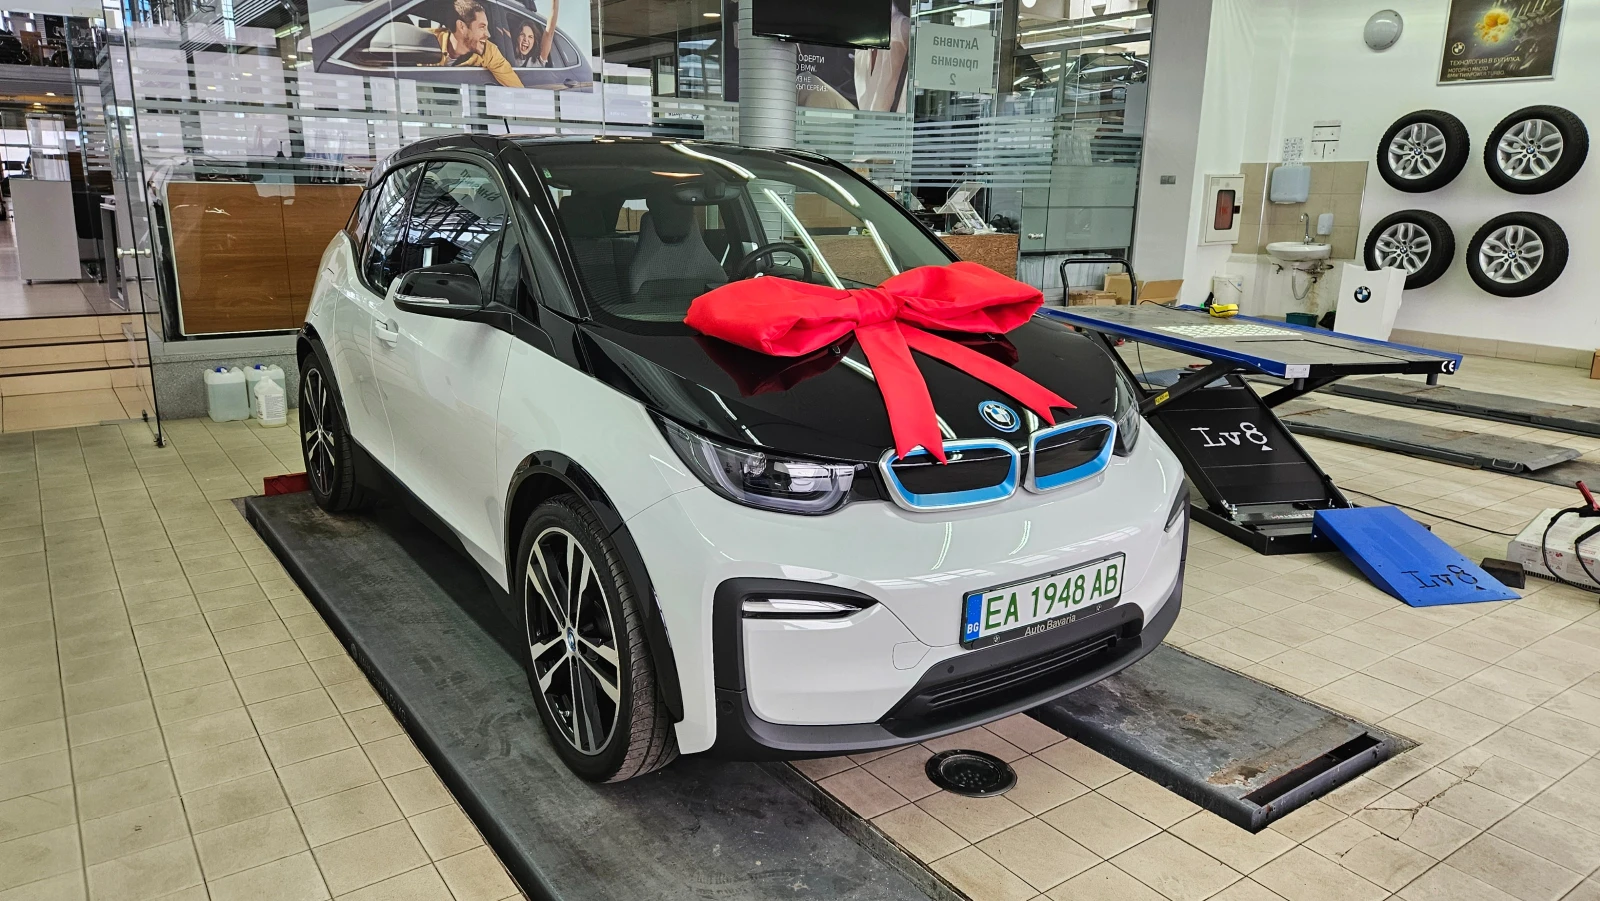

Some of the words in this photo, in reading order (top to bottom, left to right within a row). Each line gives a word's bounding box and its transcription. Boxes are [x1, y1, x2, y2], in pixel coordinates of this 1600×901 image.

[798, 53, 825, 64] ОФЕРТИ
[1190, 421, 1268, 448] Lv8
[985, 592, 1019, 630] EA
[1031, 574, 1085, 618] 1948
[1089, 563, 1119, 600] AB
[966, 622, 980, 634] BG
[1024, 624, 1045, 636] Auto
[1046, 613, 1077, 630] Bavaria
